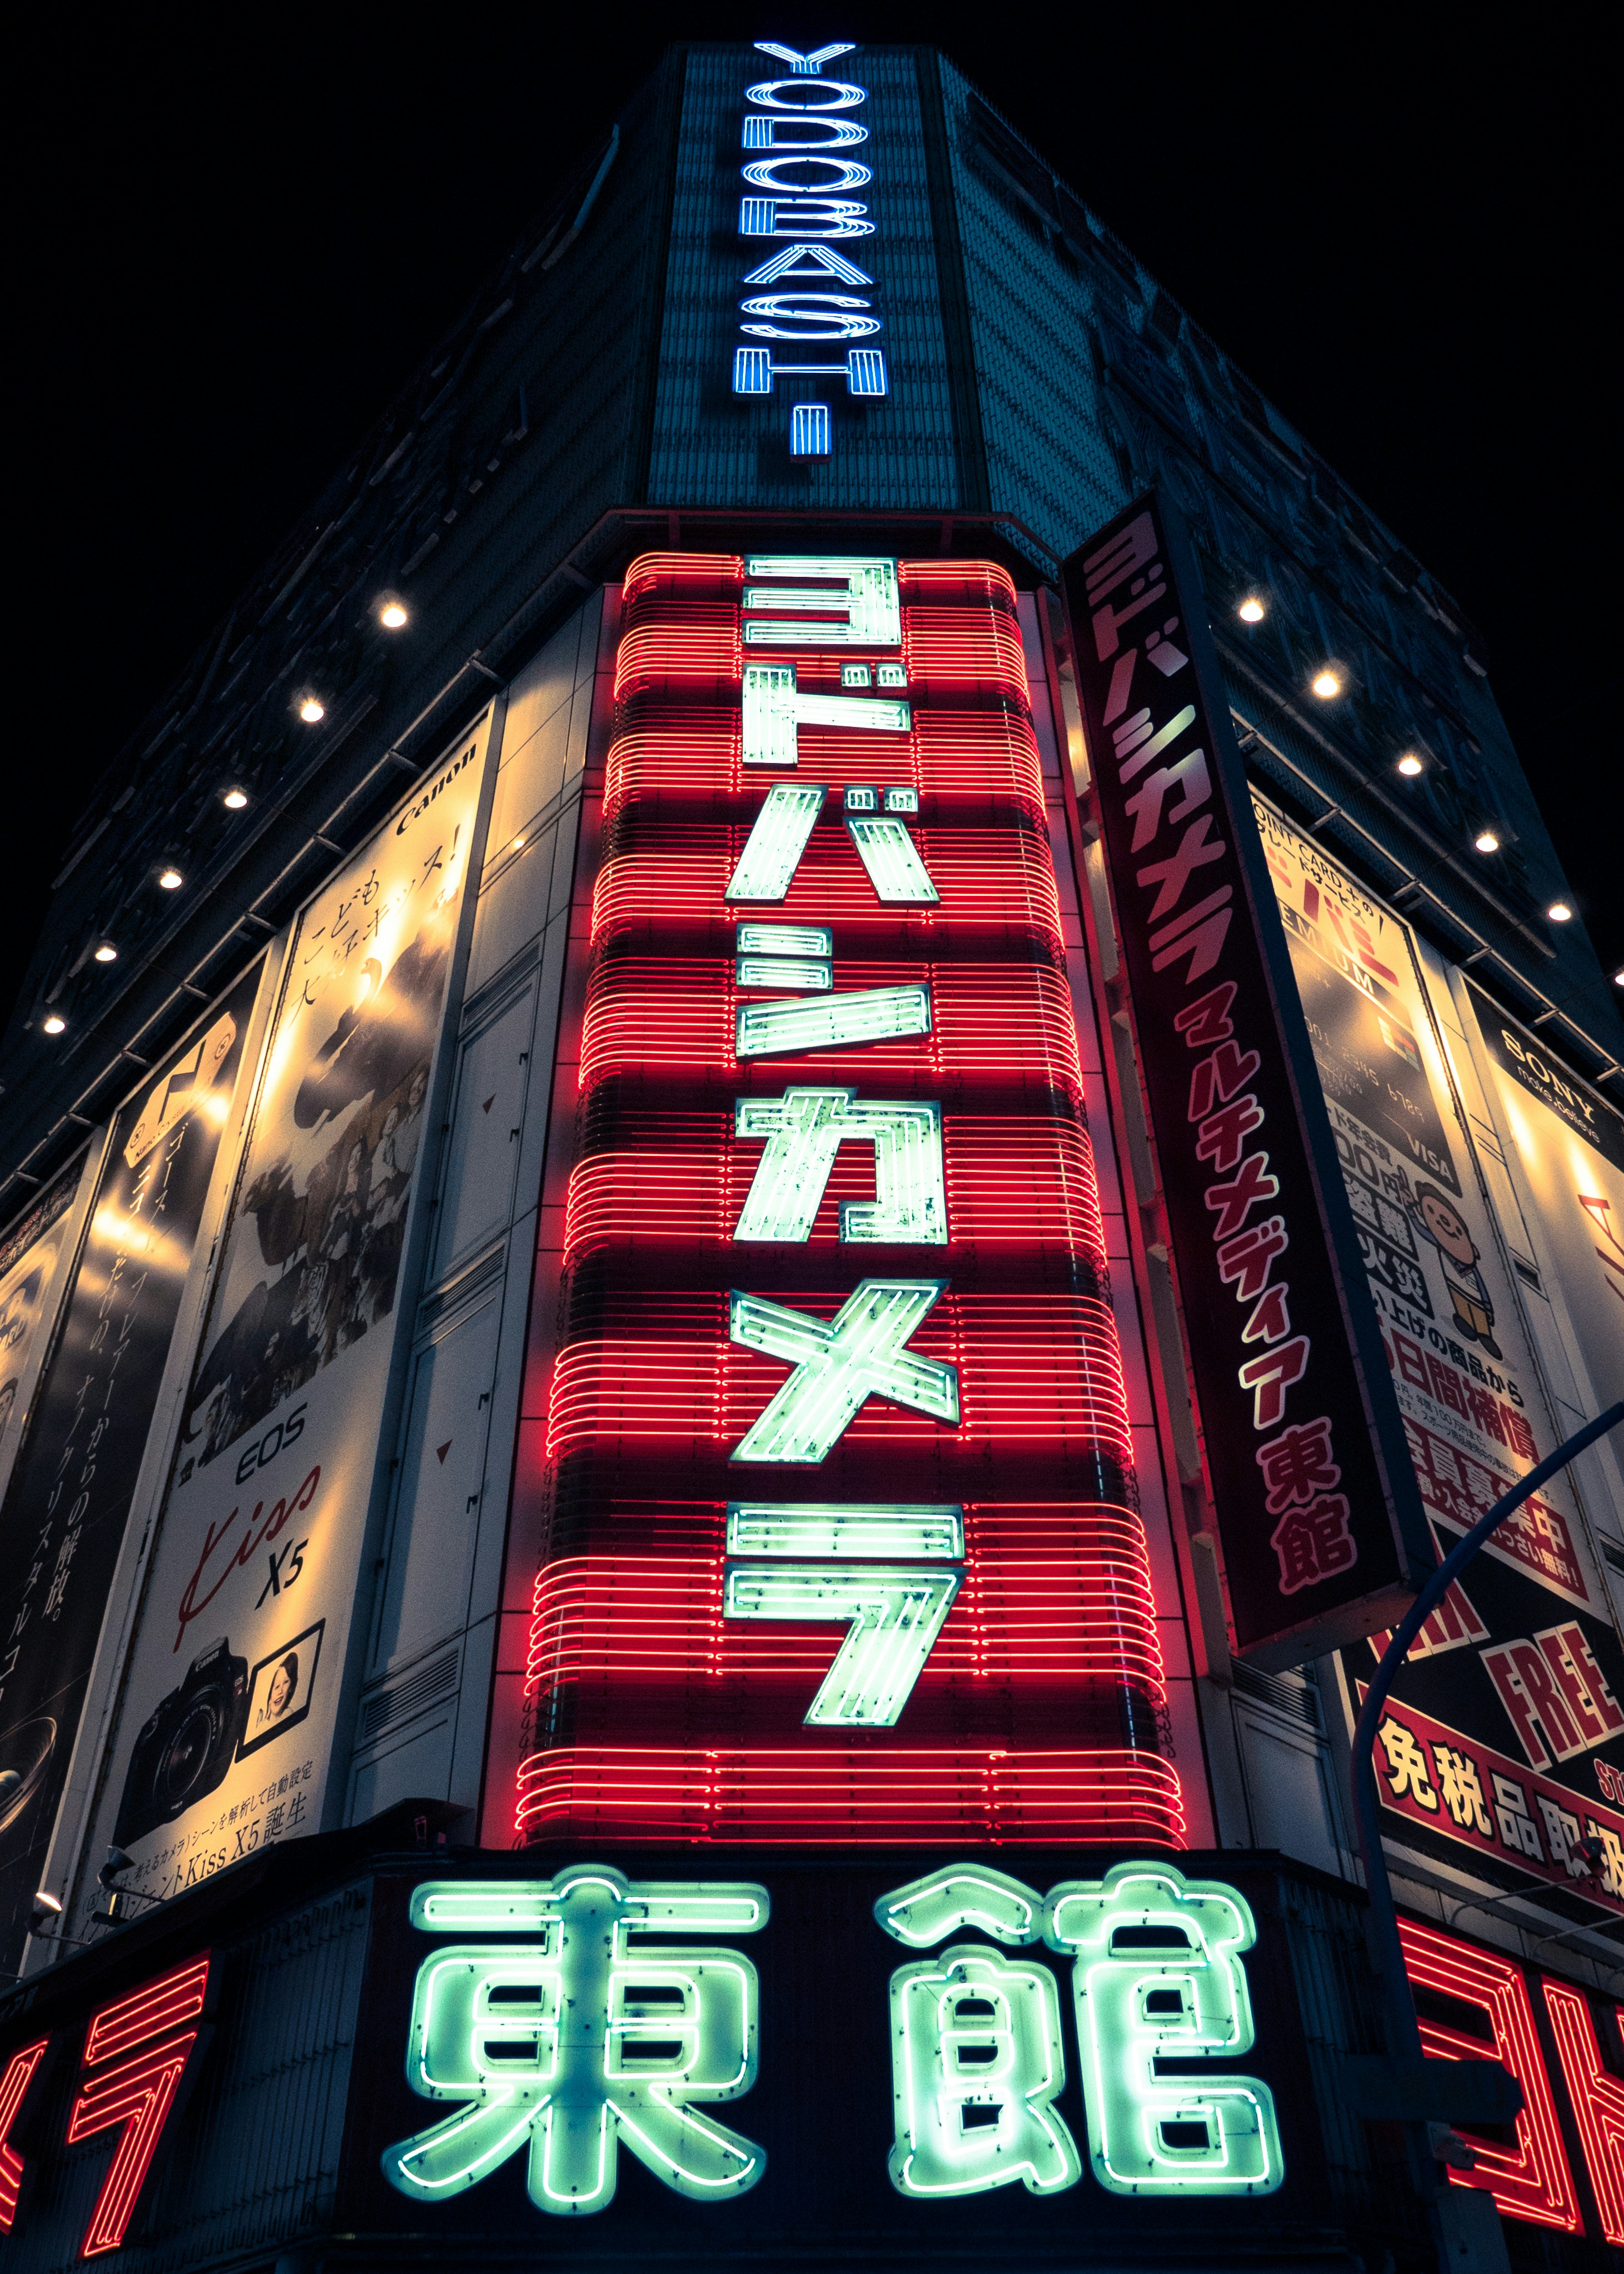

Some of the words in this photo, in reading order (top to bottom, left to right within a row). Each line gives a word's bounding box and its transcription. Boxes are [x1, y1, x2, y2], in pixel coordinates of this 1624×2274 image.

[732, 43, 887, 455] YODOBASHI
[396, 743, 476, 835] Canon
[1083, 511, 1233, 984] ヨドバシカメラ
[1298, 844, 1342, 888] CARD
[304, 869, 379, 965] こども
[1501, 1030, 1595, 1124] SONY
[723, 555, 970, 1727] ヨドバシカメラ
[1407, 1136, 1456, 1184] VISA
[236, 1402, 308, 1485] EOS
[173, 1465, 321, 1654] Kiss
[254, 1538, 309, 1610] X5
[196, 1649, 219, 1672] Canon
[1478, 1619, 1624, 1773] FREE
[231, 1819, 261, 1861] X5
[262, 1791, 308, 1842] 誕生
[1593, 1758, 1624, 1807] ST
[382, 1861, 1285, 2215] 東館
